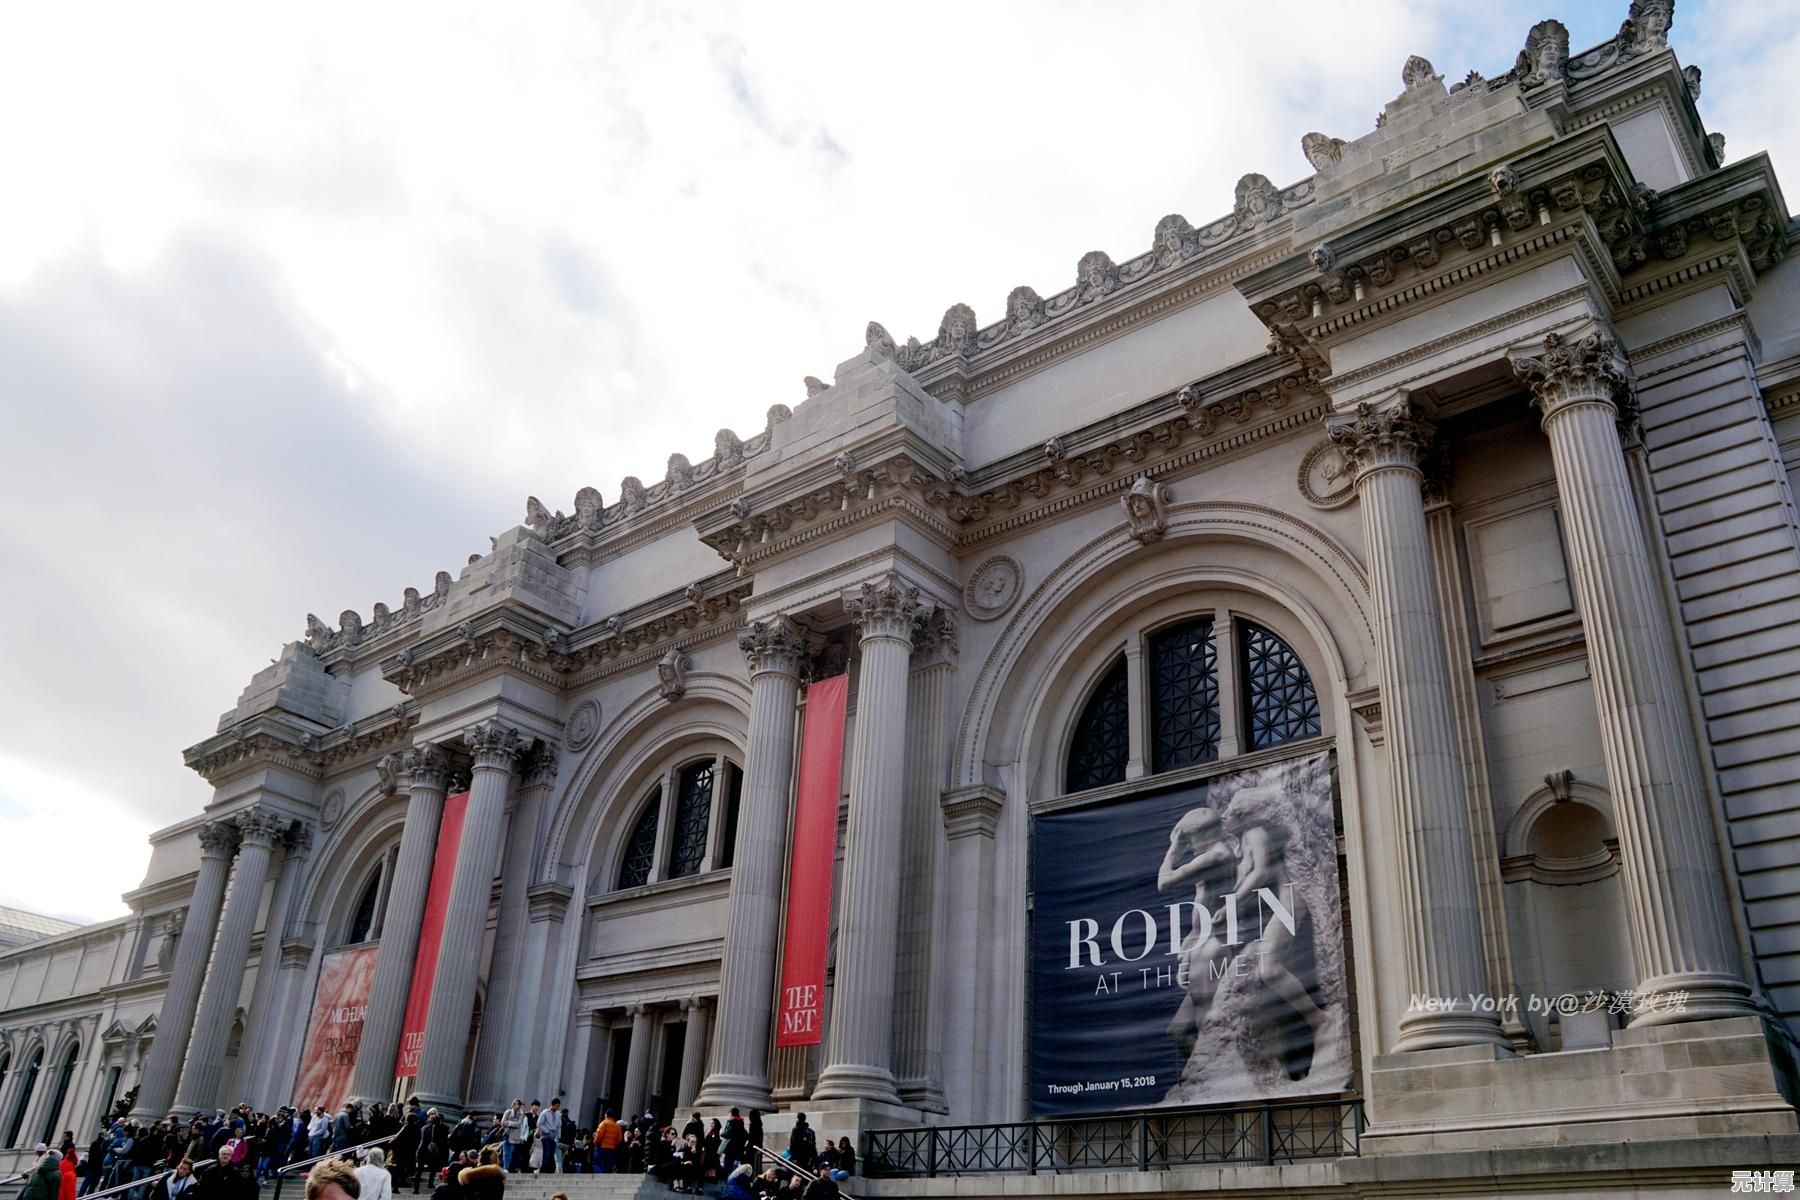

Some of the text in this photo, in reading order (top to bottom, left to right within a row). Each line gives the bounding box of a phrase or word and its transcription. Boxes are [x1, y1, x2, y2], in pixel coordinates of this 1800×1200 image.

[1064, 882, 1298, 970] RODIN
[1094, 951, 1270, 996] AT THE MET
[786, 985, 817, 1010] THE
[783, 1009, 817, 1035] MET
[1048, 1076, 1156, 1095] Through January 15, 2018
